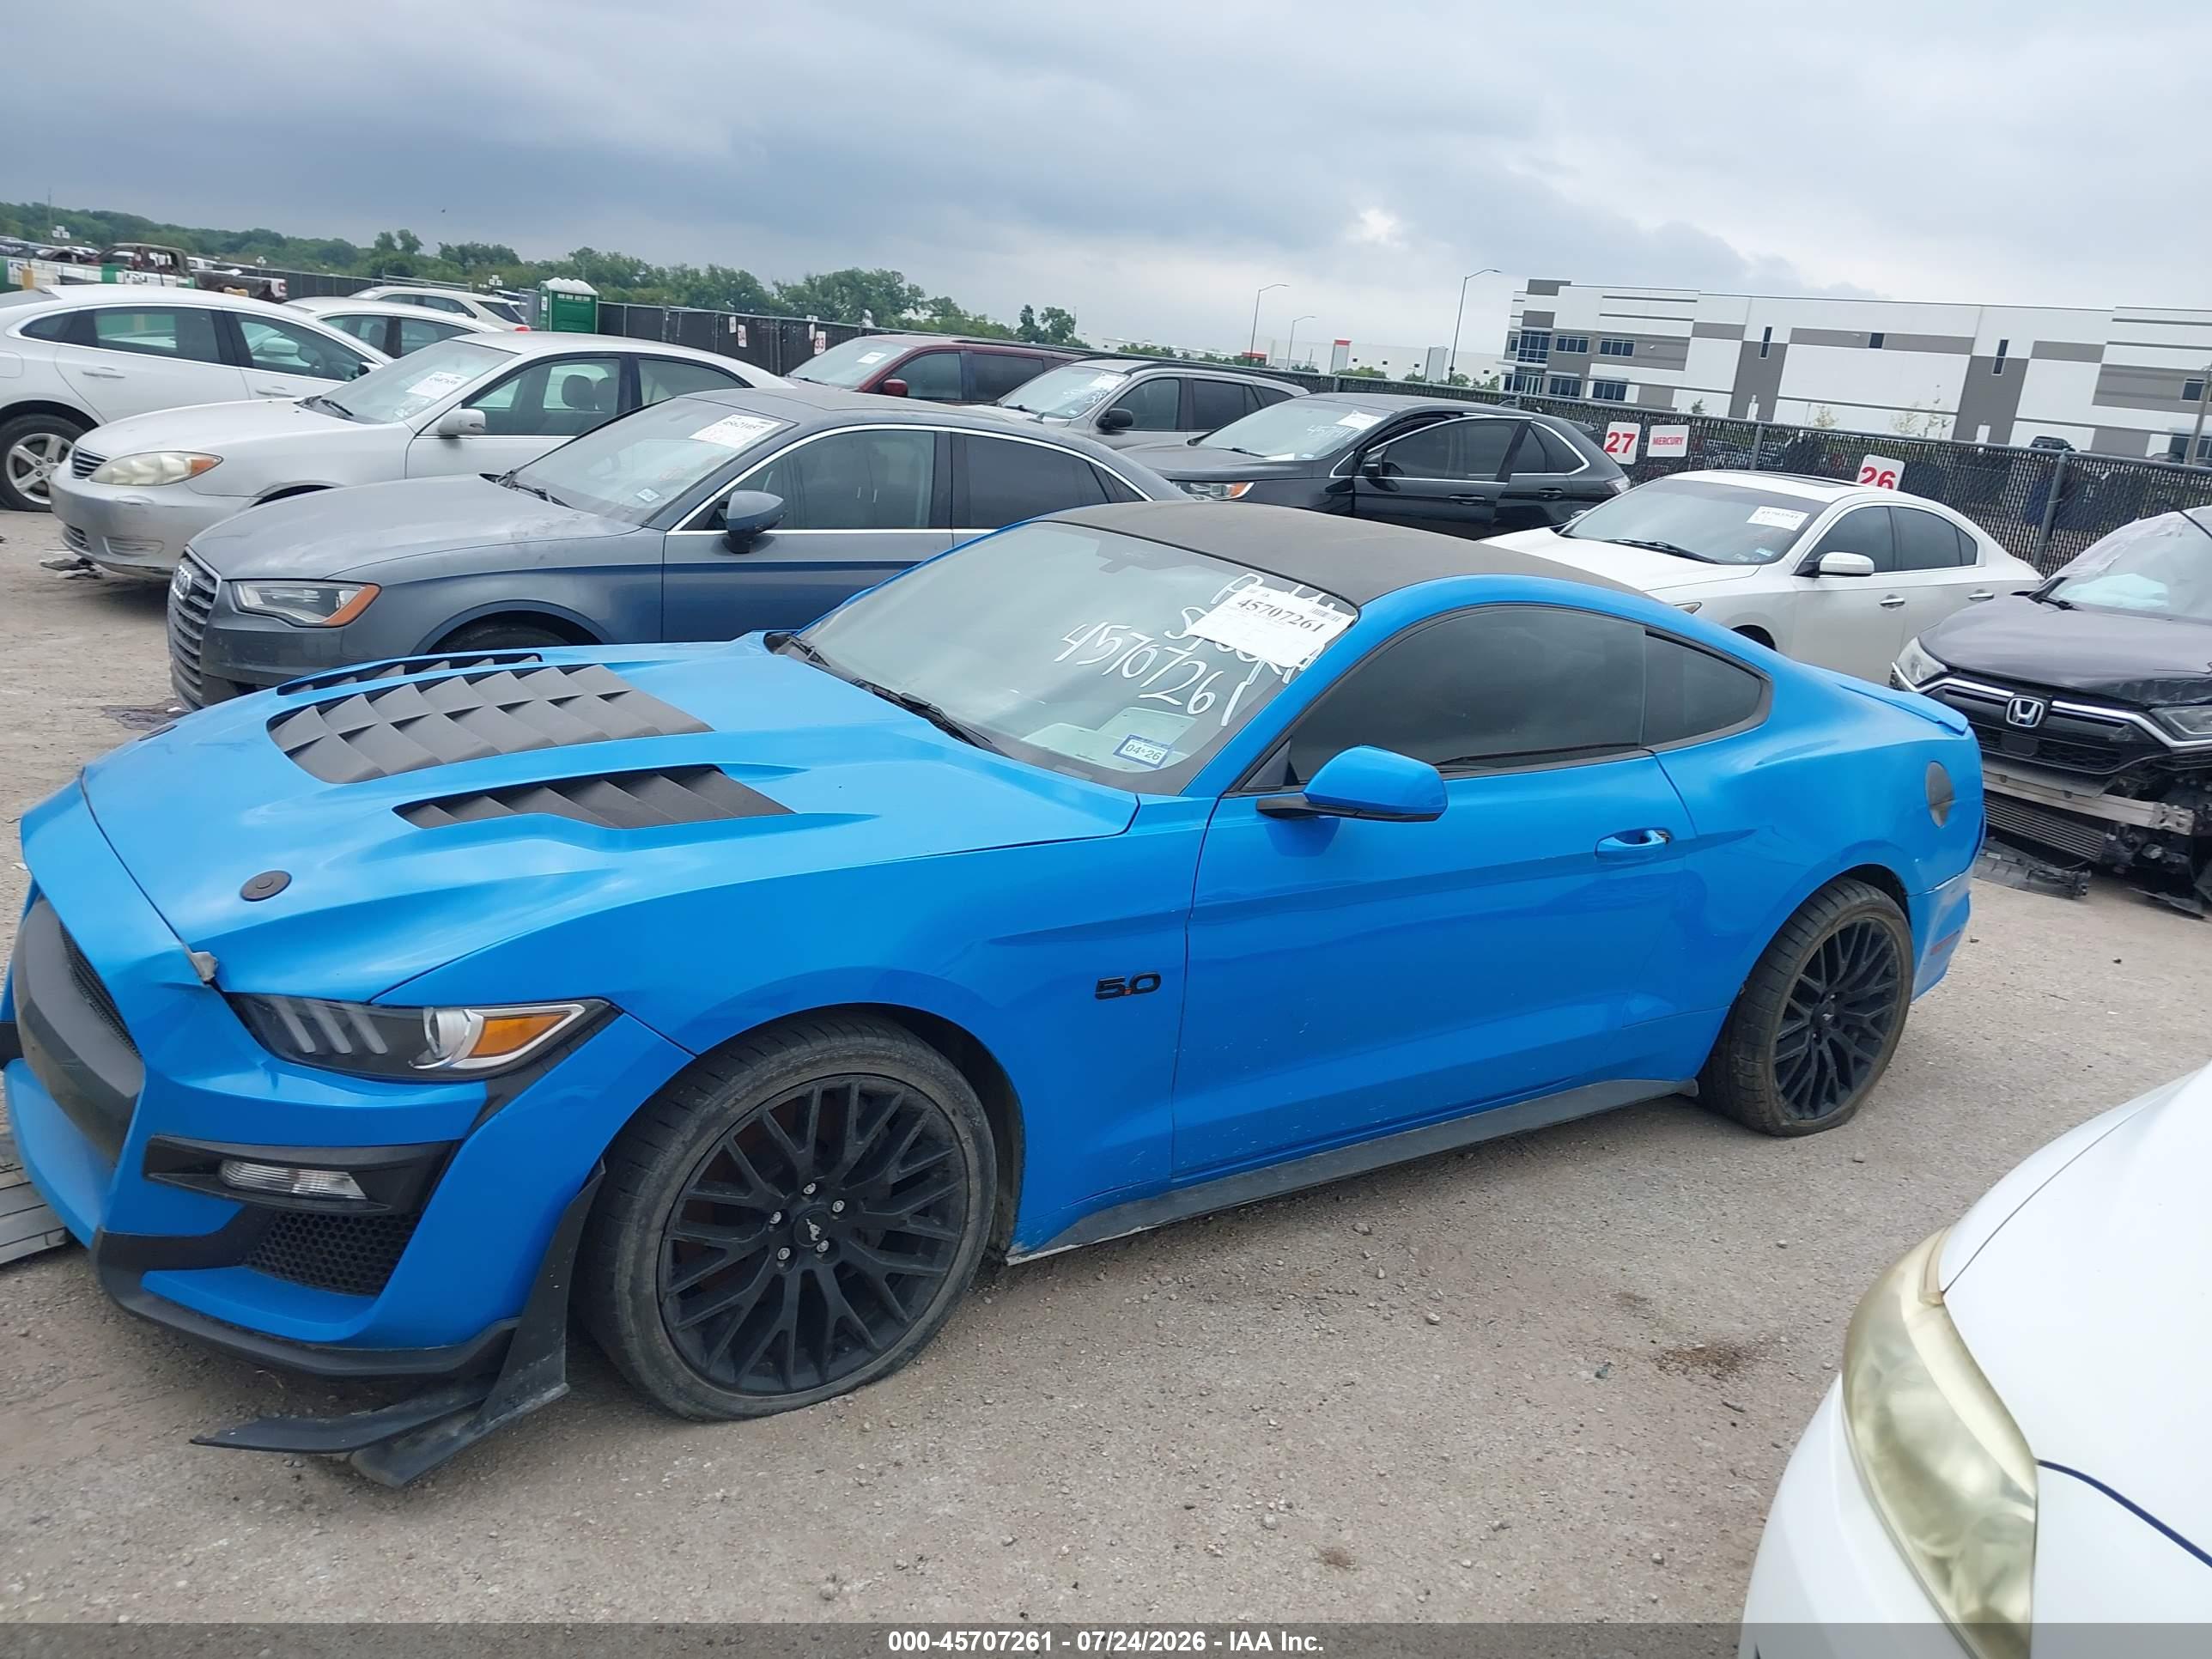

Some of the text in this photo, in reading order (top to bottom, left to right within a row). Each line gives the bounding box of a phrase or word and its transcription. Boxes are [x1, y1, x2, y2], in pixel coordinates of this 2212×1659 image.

[1604, 431, 1637, 454] 27
[1652, 436, 1685, 446] MERCURY
[1859, 466, 1897, 490] 26
[1237, 598, 1326, 633] 45707261
[1053, 621, 1248, 727] 45707261
[1125, 744, 1163, 761] 04 26
[1095, 971, 1162, 1000] 5.0
